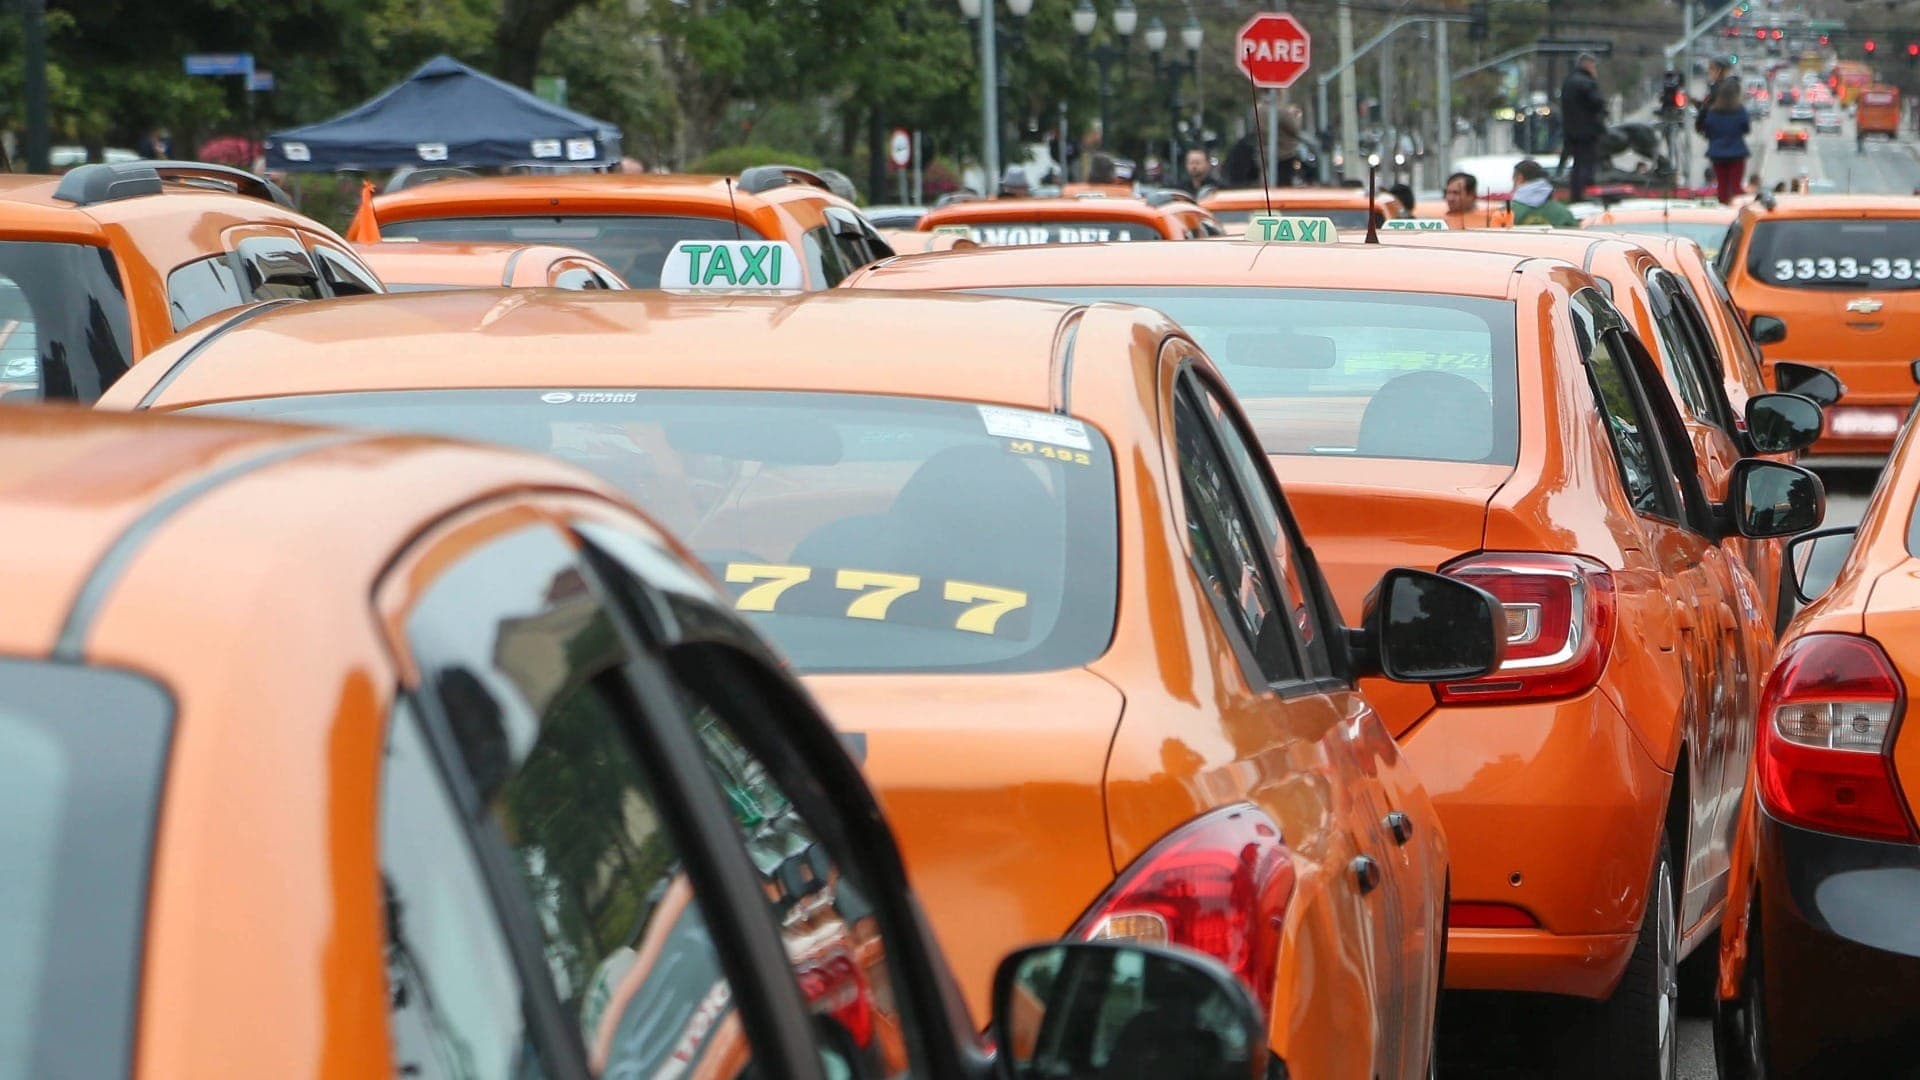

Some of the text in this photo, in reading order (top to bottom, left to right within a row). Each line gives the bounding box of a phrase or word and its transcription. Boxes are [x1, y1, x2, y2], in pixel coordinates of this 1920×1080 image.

[1241, 39, 1305, 63] PARE
[1257, 219, 1327, 242] TAXI
[680, 244, 781, 286] TAXI
